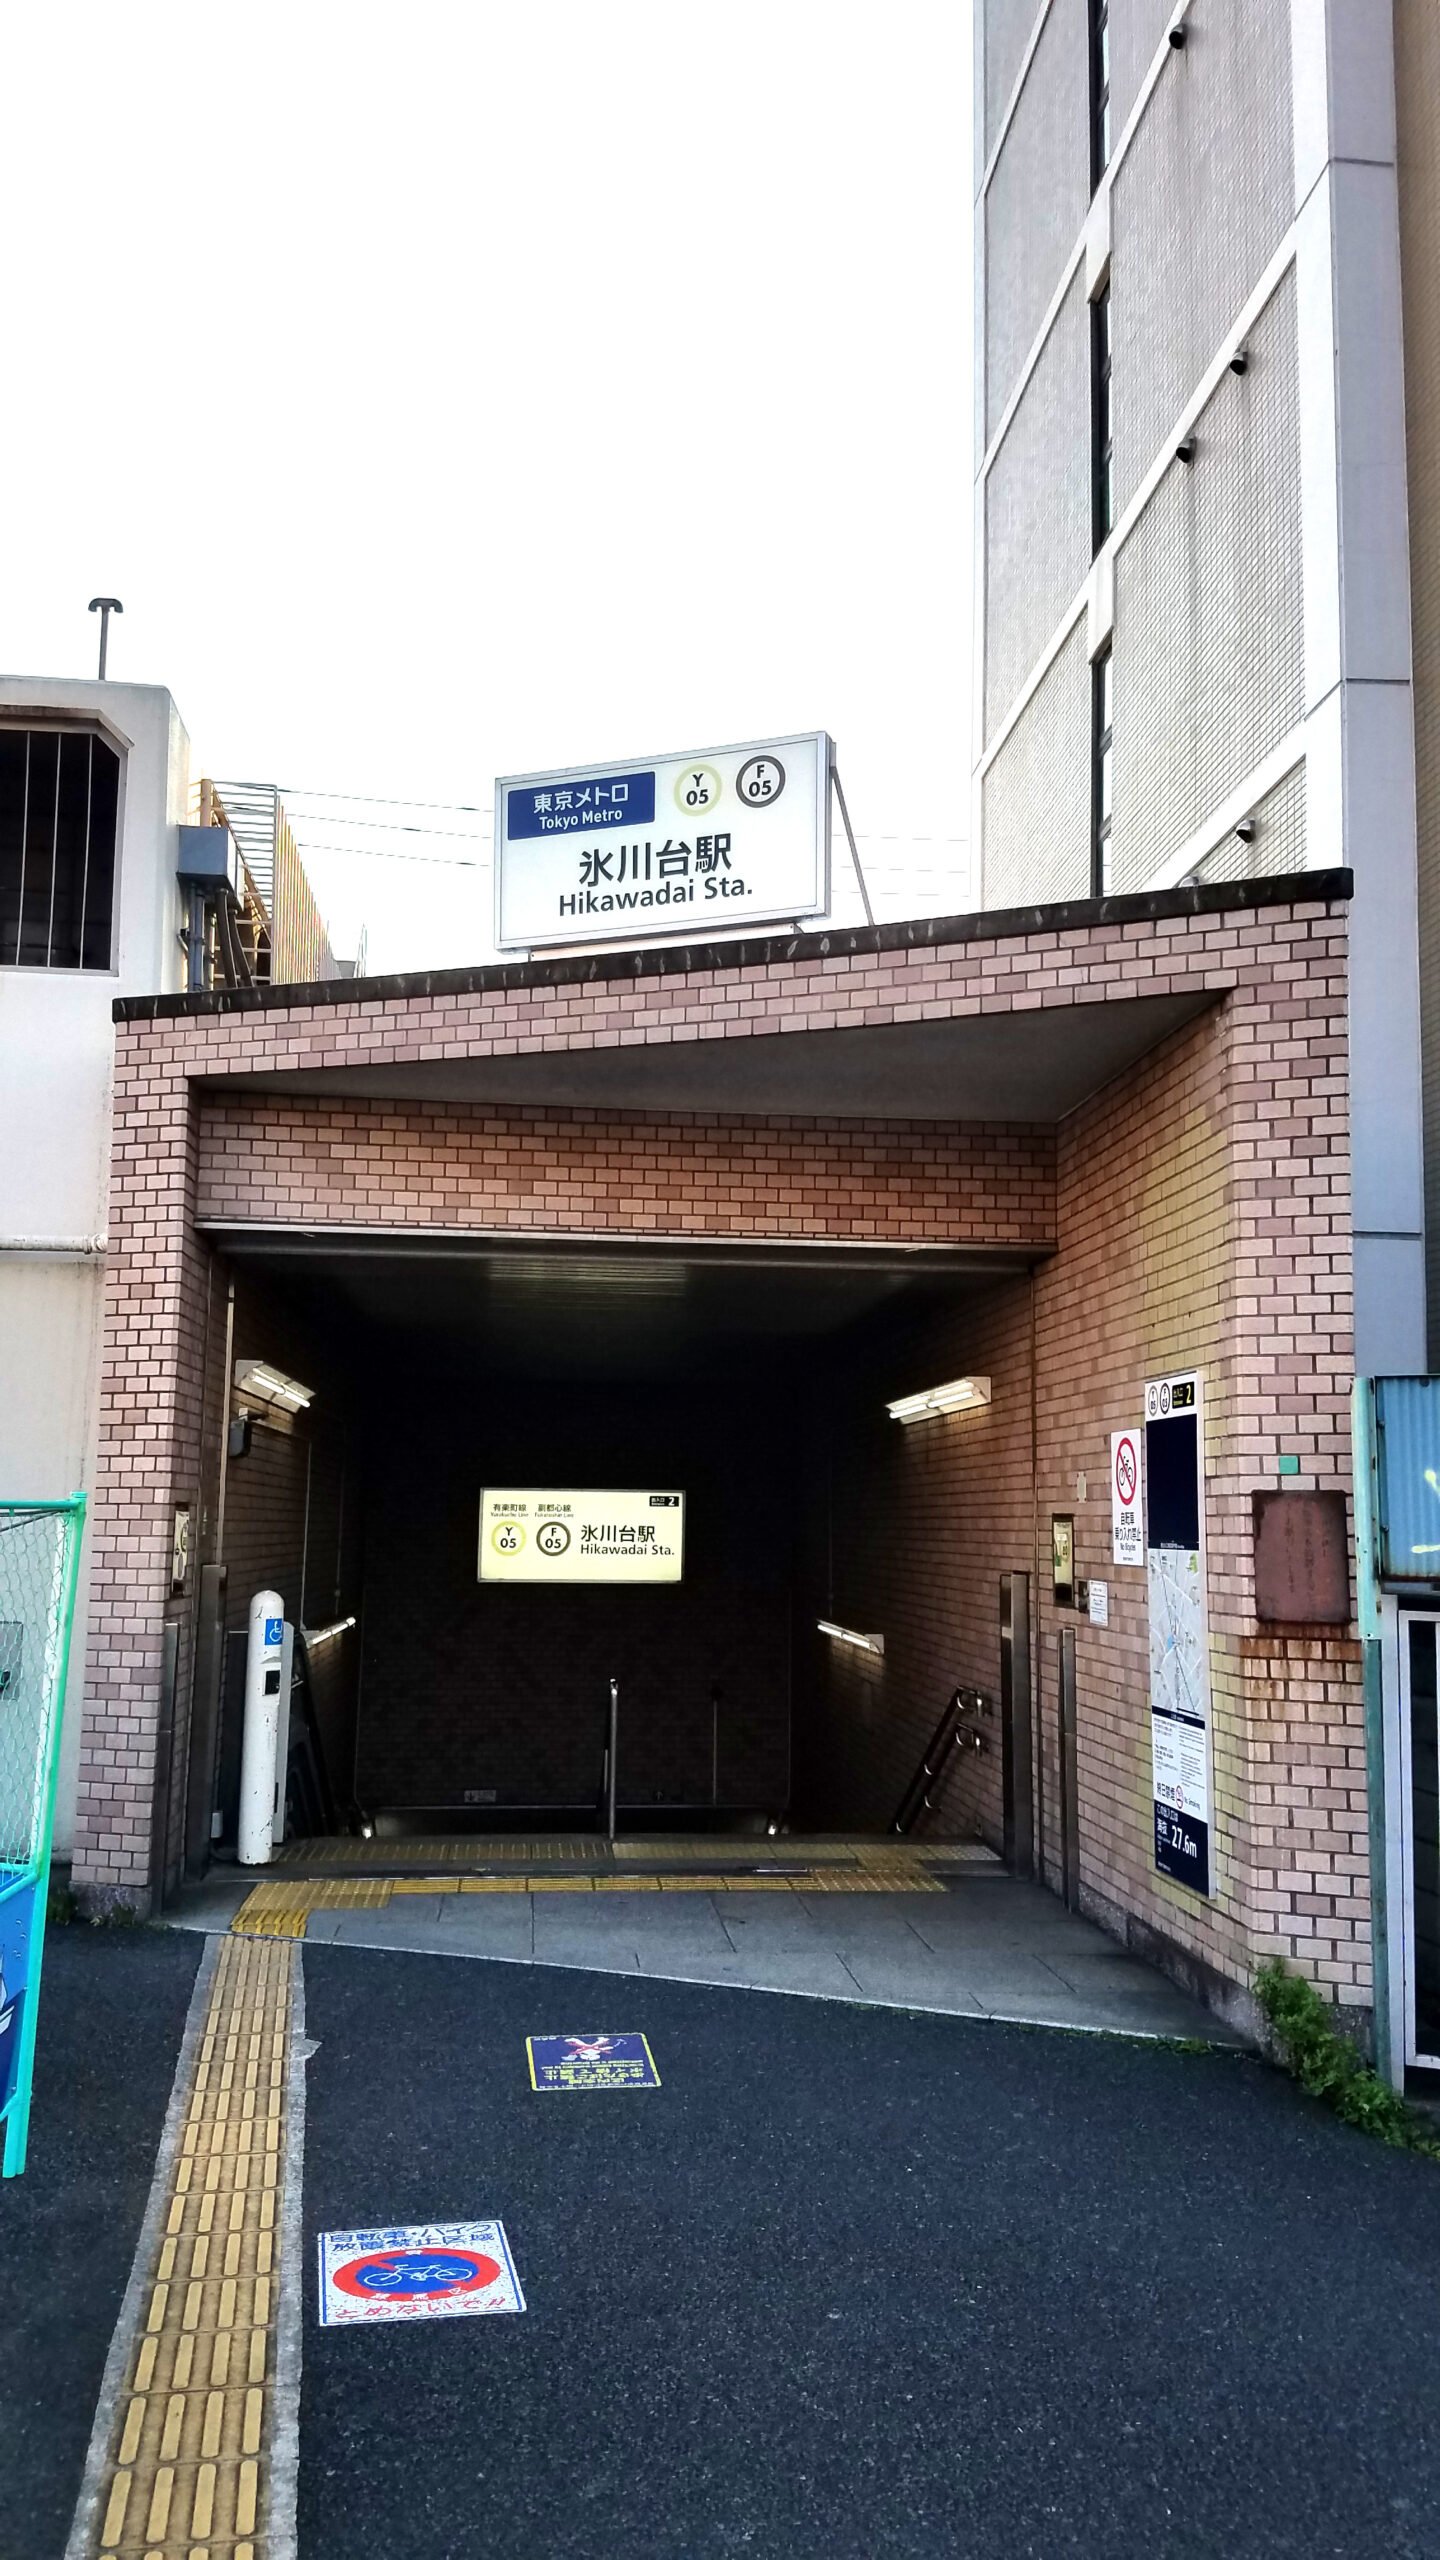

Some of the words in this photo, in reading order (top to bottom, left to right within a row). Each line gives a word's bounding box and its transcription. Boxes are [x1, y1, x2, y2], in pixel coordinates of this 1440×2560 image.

[692, 772, 704, 787] Y
[757, 764, 765, 779] F
[686, 788, 709, 806] 05
[748, 779, 772, 798] 05
[533, 783, 629, 815] 東京メトロ
[539, 812, 579, 831] Tokyo
[582, 807, 623, 826] Metro
[579, 832, 732, 888] 氷川台駅
[559, 879, 695, 917] Hikawadai
[704, 874, 753, 900] Sta.
[1186, 1384, 1192, 1404] 2
[668, 1496, 675, 1507] 2
[505, 1527, 514, 1536] Y
[551, 1528, 557, 1536] F
[581, 1525, 656, 1543] 氷川台駅
[500, 1538, 517, 1549] 05
[545, 1538, 561, 1549] 05
[581, 1544, 647, 1556] Hikawadai
[651, 1544, 675, 1555] Sta.
[1171, 1825, 1198, 1858] 27.6m
[333, 2233, 495, 2251] 放置禁止区域
